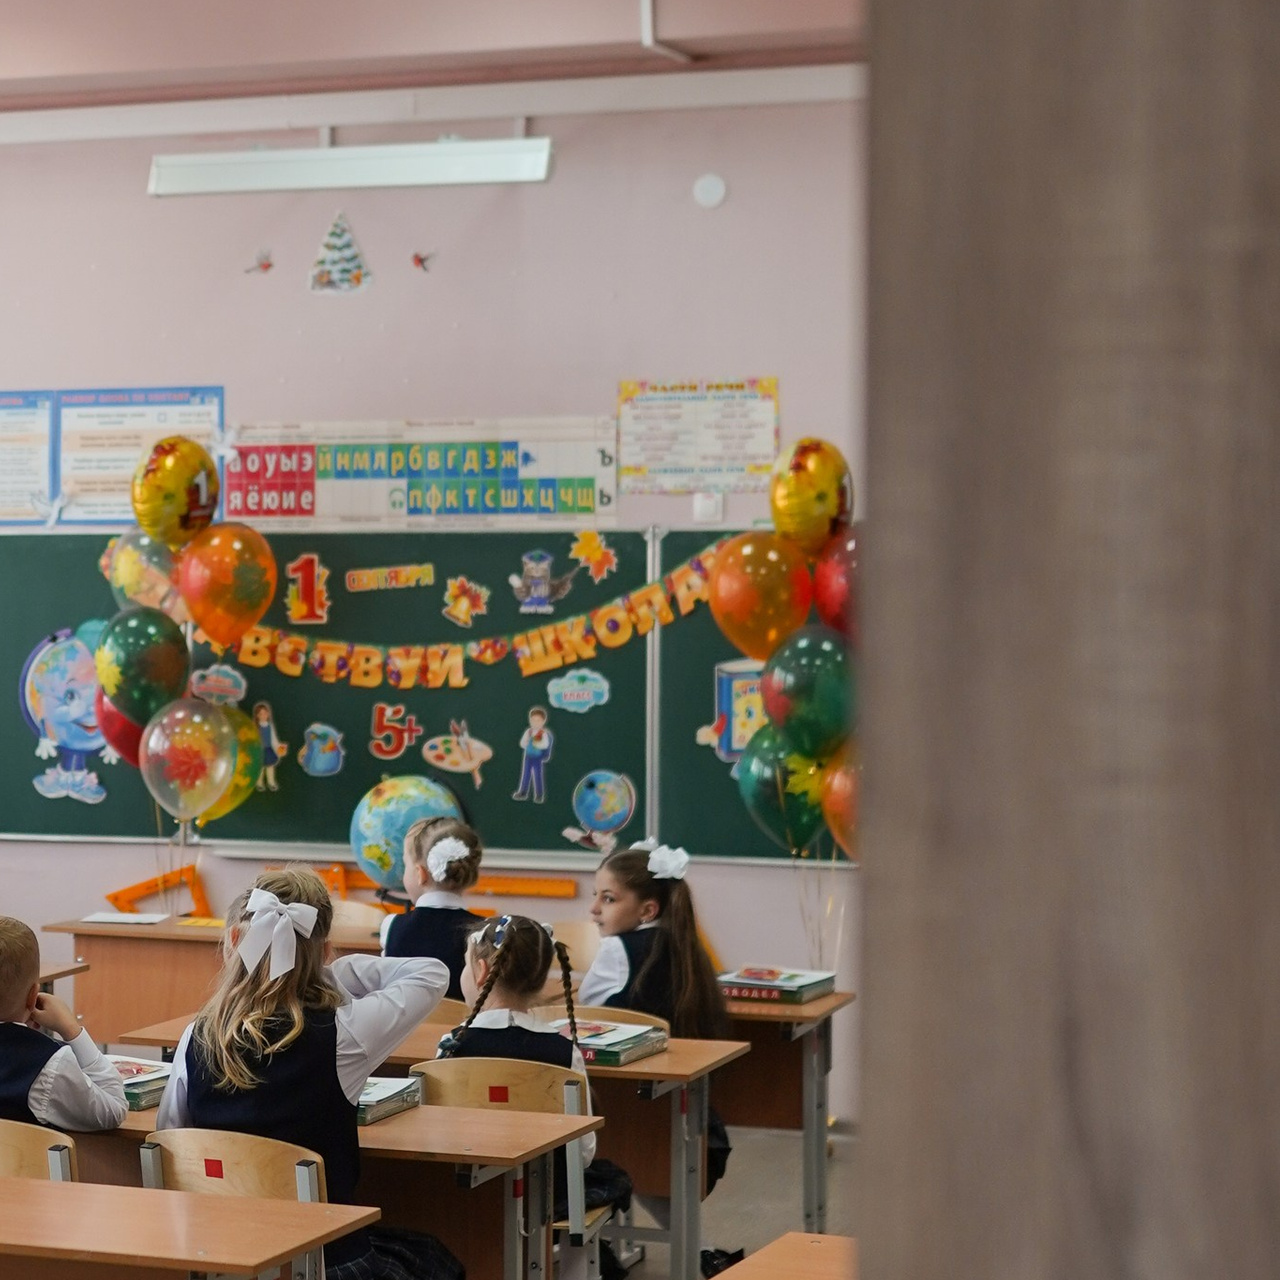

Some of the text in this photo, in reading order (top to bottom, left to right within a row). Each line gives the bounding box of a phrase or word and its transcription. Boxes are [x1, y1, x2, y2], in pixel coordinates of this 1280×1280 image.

[193, 469, 208, 507] 1
[288, 555, 327, 624] 1
[193, 626, 469, 689] ВСТВУЙ
[370, 703, 423, 760] 5+
[722, 987, 780, 999] ОВОДЕЛ
